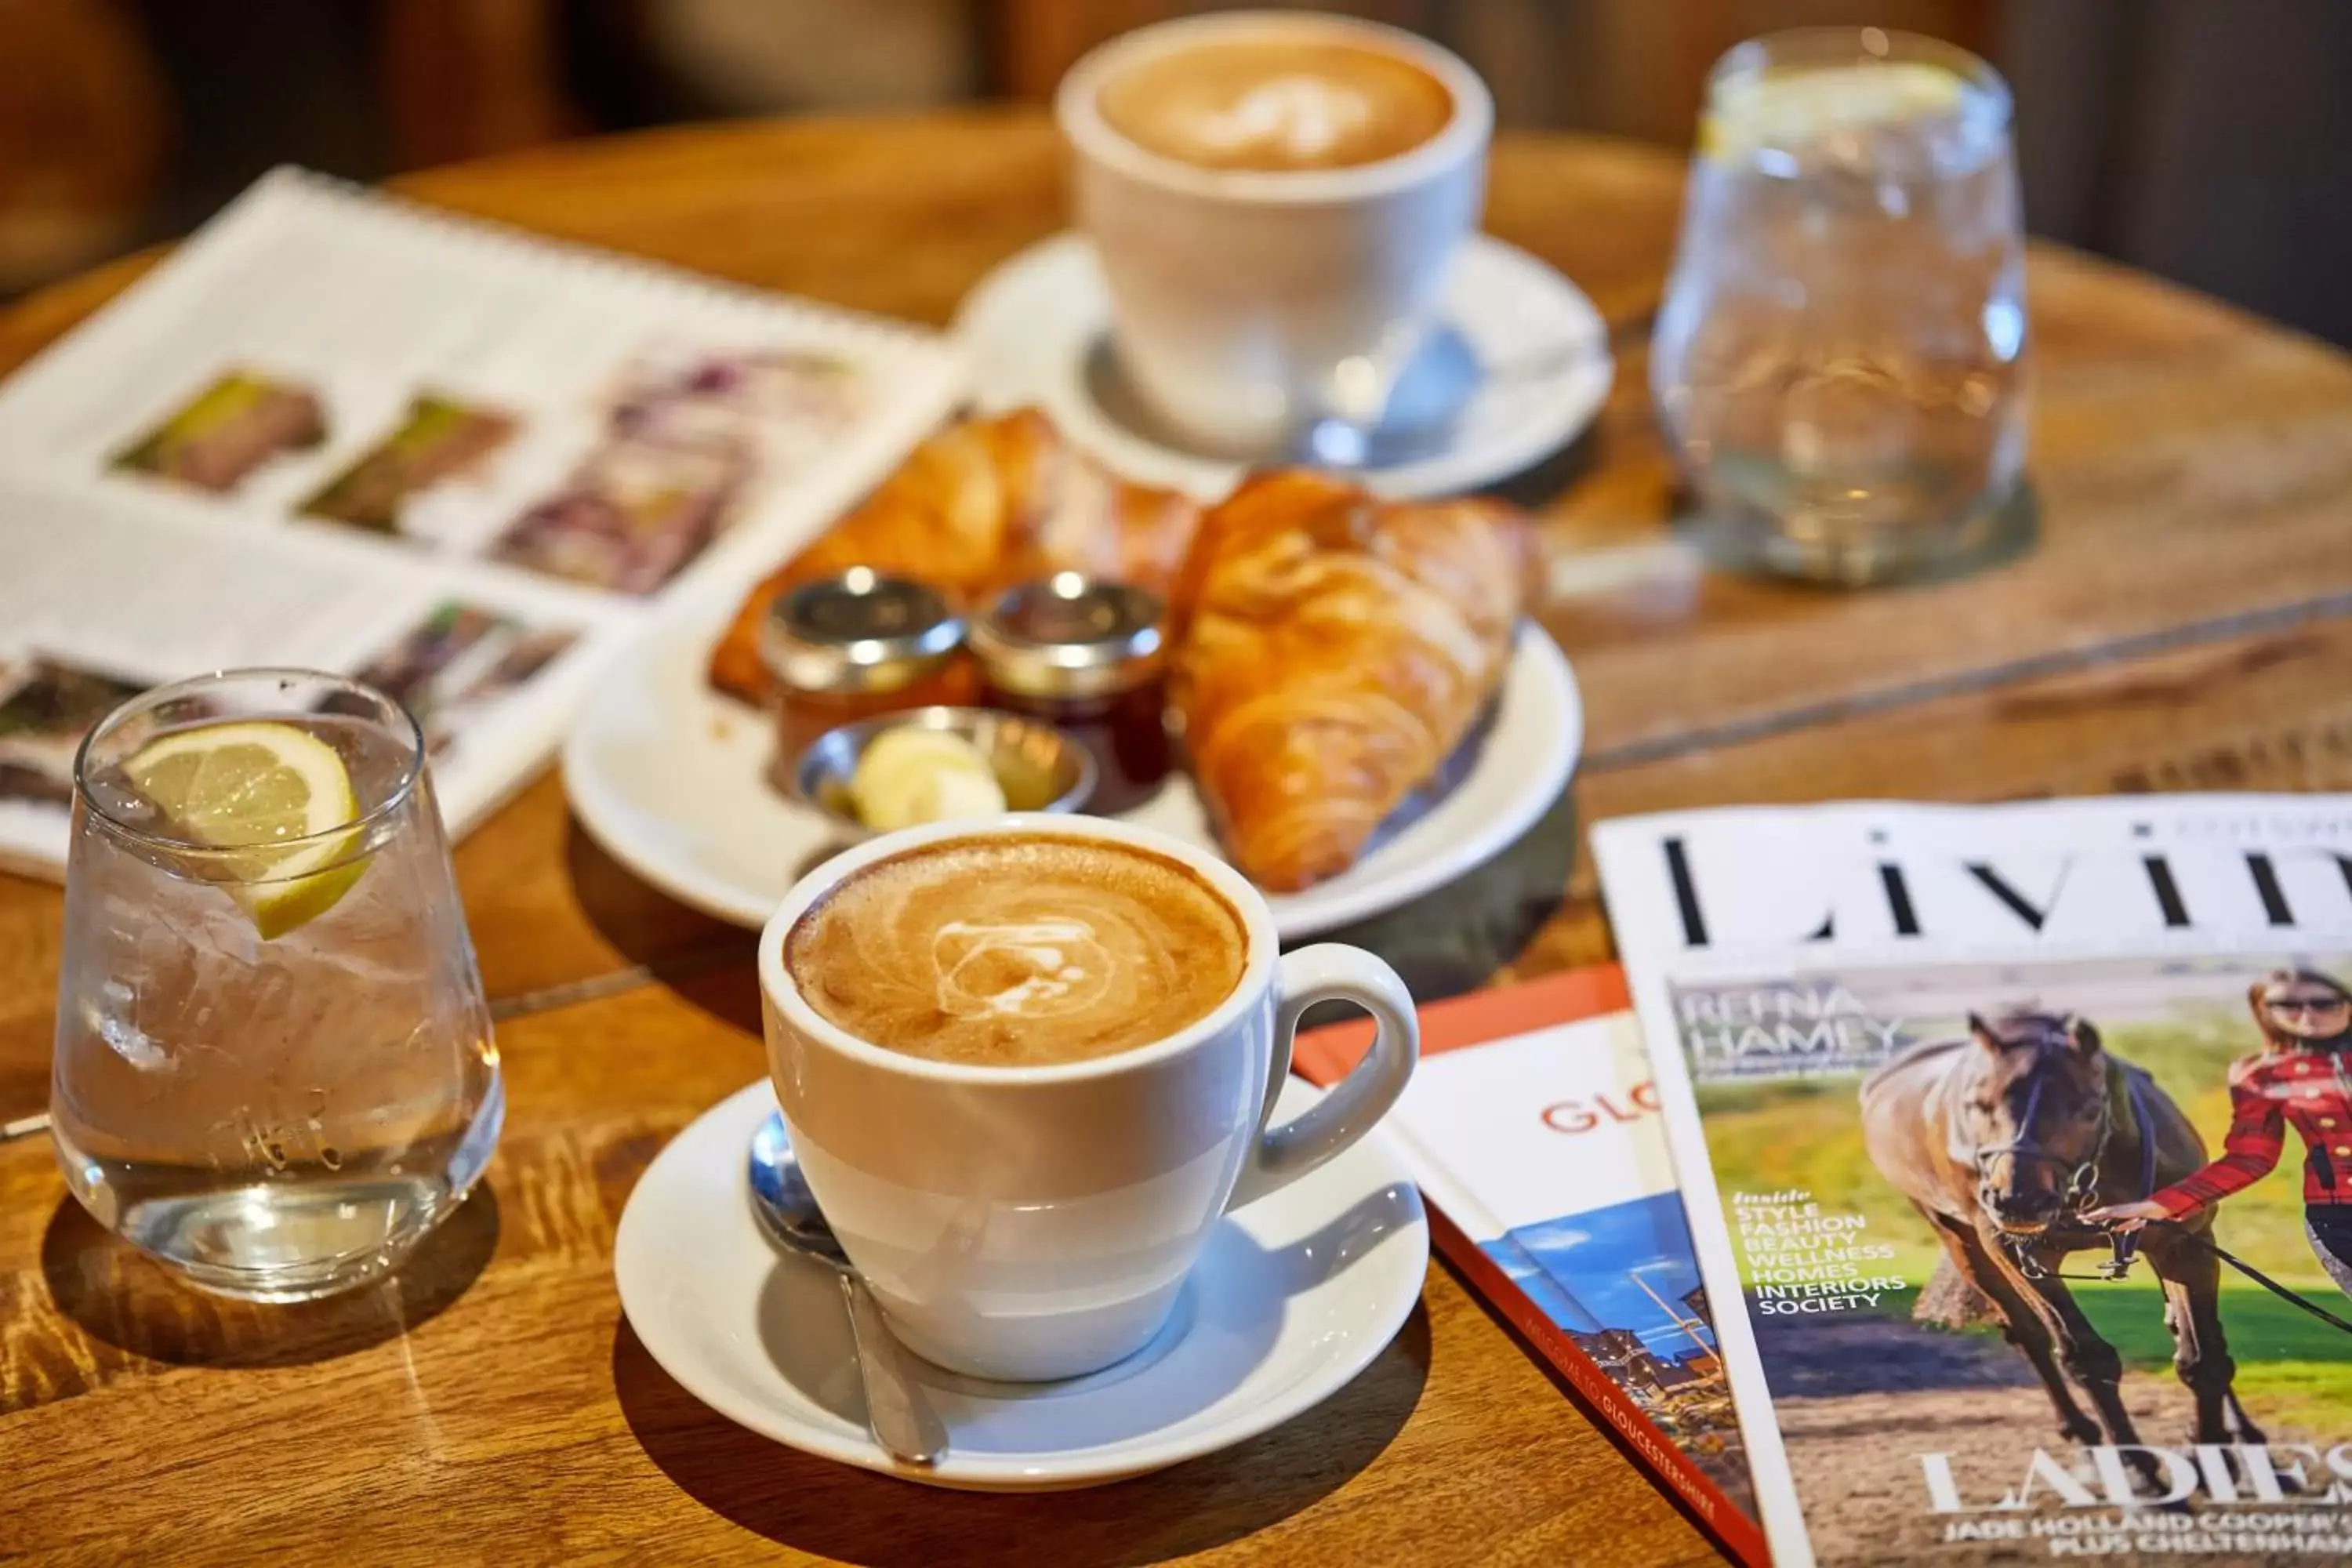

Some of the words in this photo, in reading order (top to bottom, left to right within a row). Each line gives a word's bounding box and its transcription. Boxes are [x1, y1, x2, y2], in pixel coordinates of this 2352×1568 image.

[1732, 1189, 1811, 1204] Inside
[1735, 1203, 1819, 1222] STYLE
[1740, 1214, 1867, 1236] FASHION
[1743, 1231, 1857, 1253] BEAUTY
[1747, 1243, 1896, 1268] WELLNESS
[1751, 1261, 1859, 1283] HOMES
[1755, 1275, 1907, 1299] INTERIORS
[1759, 1293, 1882, 1315] SOCIETY
[1584, 1374, 1600, 1401] TO
[1602, 1395, 1715, 1521] GLOUCESTERSHIRE
[1944, 1520, 2025, 1543] JADE
[2030, 1512, 2194, 1537] HOLLAND
[2049, 1530, 2132, 1558] PLUS
